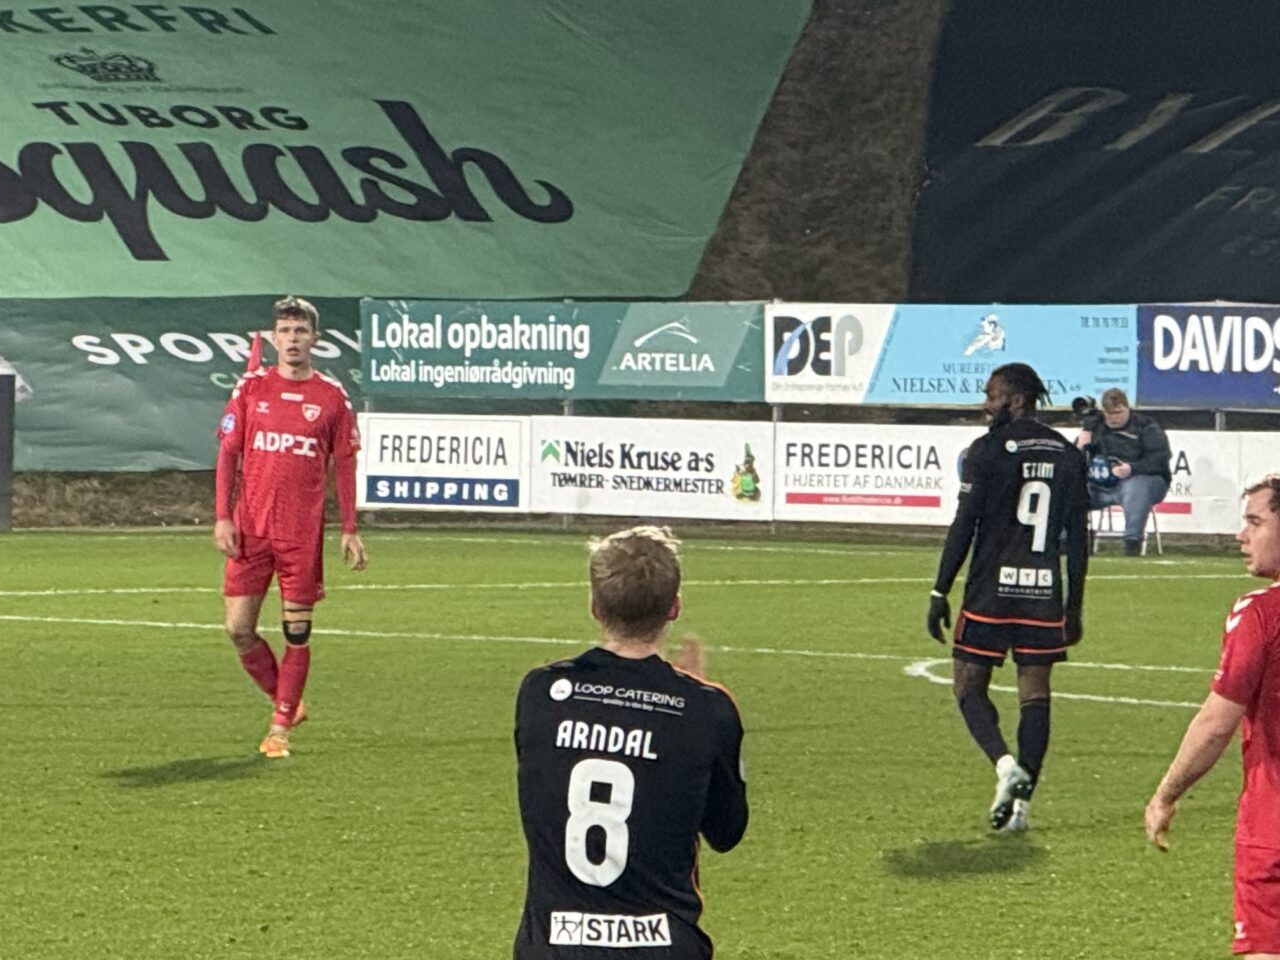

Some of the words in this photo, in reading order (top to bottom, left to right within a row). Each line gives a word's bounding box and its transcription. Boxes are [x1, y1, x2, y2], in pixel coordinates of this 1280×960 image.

[32, 101, 310, 131] TUBORG
[371, 313, 443, 349] Lokal
[447, 314, 591, 359] opbakning
[773, 315, 864, 376] DEP
[371, 359, 416, 382] Lokal
[419, 358, 575, 389] ingeniørrådgivning
[619, 352, 715, 372] ARTELIA
[891, 377, 958, 394] NIELSEN
[960, 378, 970, 394] &
[378, 433, 509, 466] FREDERICIA
[564, 440, 614, 469] Niels
[619, 443, 682, 471] Kruse
[786, 443, 942, 470] FREDERICIA
[376, 479, 510, 501] SHIPPING
[612, 475, 725, 495] SNEDKERMESTER
[793, 474, 851, 488] HJERTET
[853, 475, 870, 488] AF
[875, 475, 943, 490] DANMARK
[1016, 481, 1052, 553] 9
[574, 682, 614, 695] LOOP
[614, 687, 686, 708] CATERING
[556, 720, 658, 760] ARNDAL
[565, 758, 636, 888] 8
[586, 916, 667, 943] STARK
